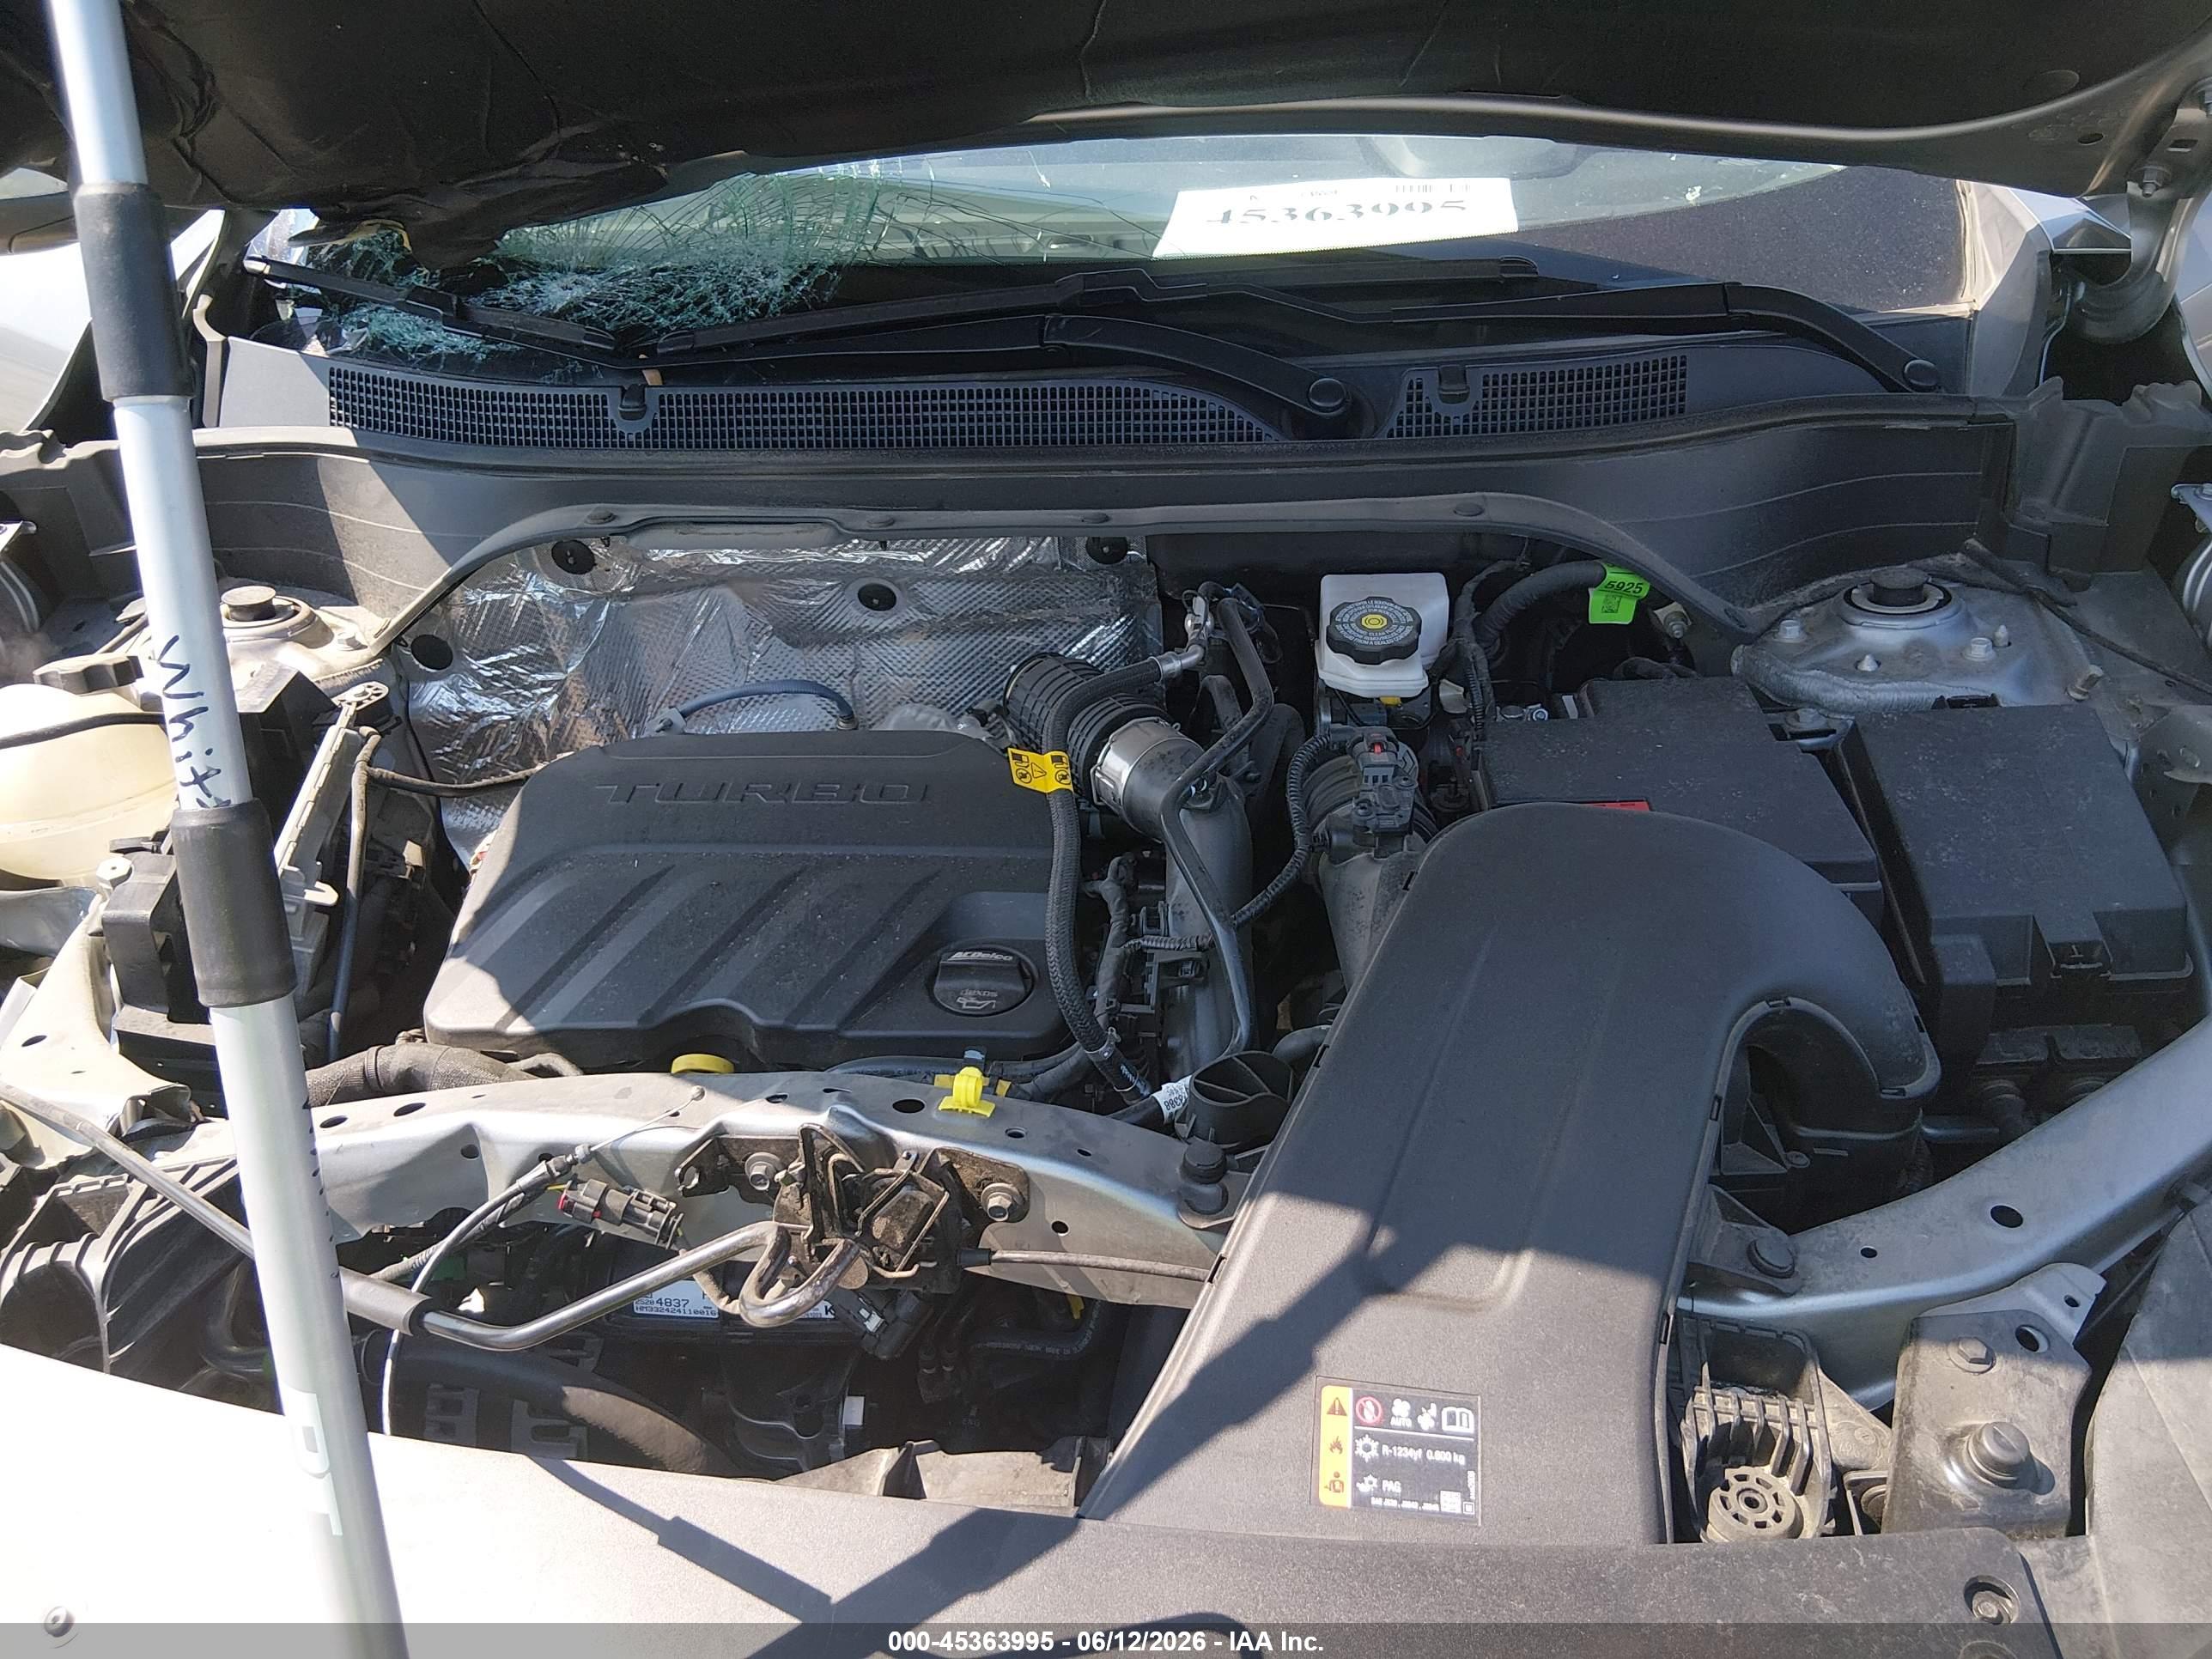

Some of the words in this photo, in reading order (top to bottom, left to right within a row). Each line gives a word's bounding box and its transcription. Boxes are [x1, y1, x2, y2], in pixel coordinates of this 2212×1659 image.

[1604, 580, 1644, 594] 5925
[596, 782, 963, 804] TURBO
[947, 951, 1013, 961] ACDelco
[656, 1297, 690, 1308] 4837
[1390, 1416, 1413, 1427] AUTO
[1382, 1444, 1422, 1461] R-1234yf
[1382, 1480, 1401, 1493] PAG
